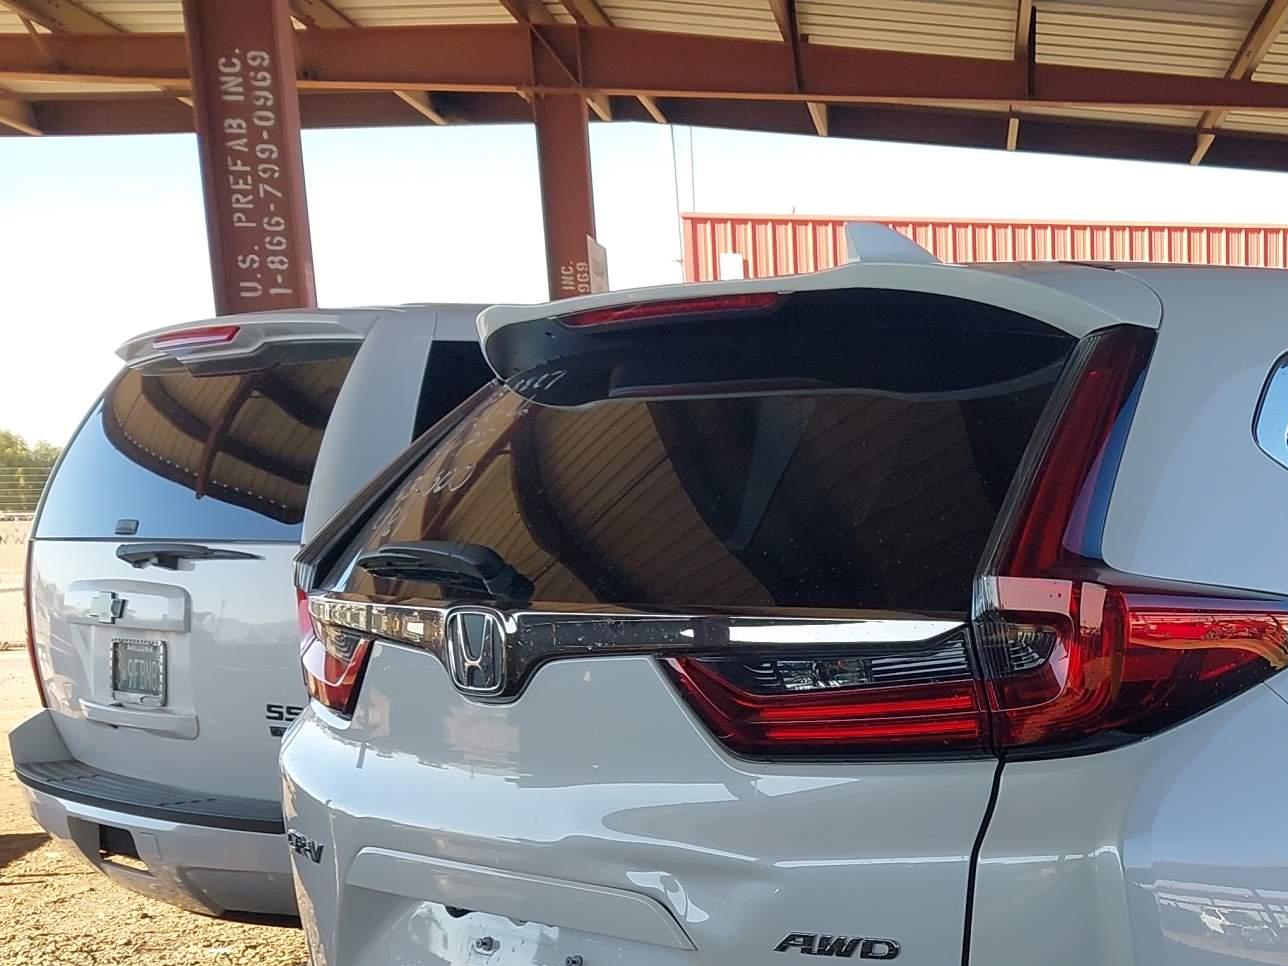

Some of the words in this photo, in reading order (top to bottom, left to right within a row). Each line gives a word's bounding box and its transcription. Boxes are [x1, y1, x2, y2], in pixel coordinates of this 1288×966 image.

[218, 48, 244, 101] INC.
[224, 117, 256, 227] PREFAB
[237, 245, 263, 297] U.S.
[561, 260, 576, 290] INC.
[773, 930, 901, 960] AWD
